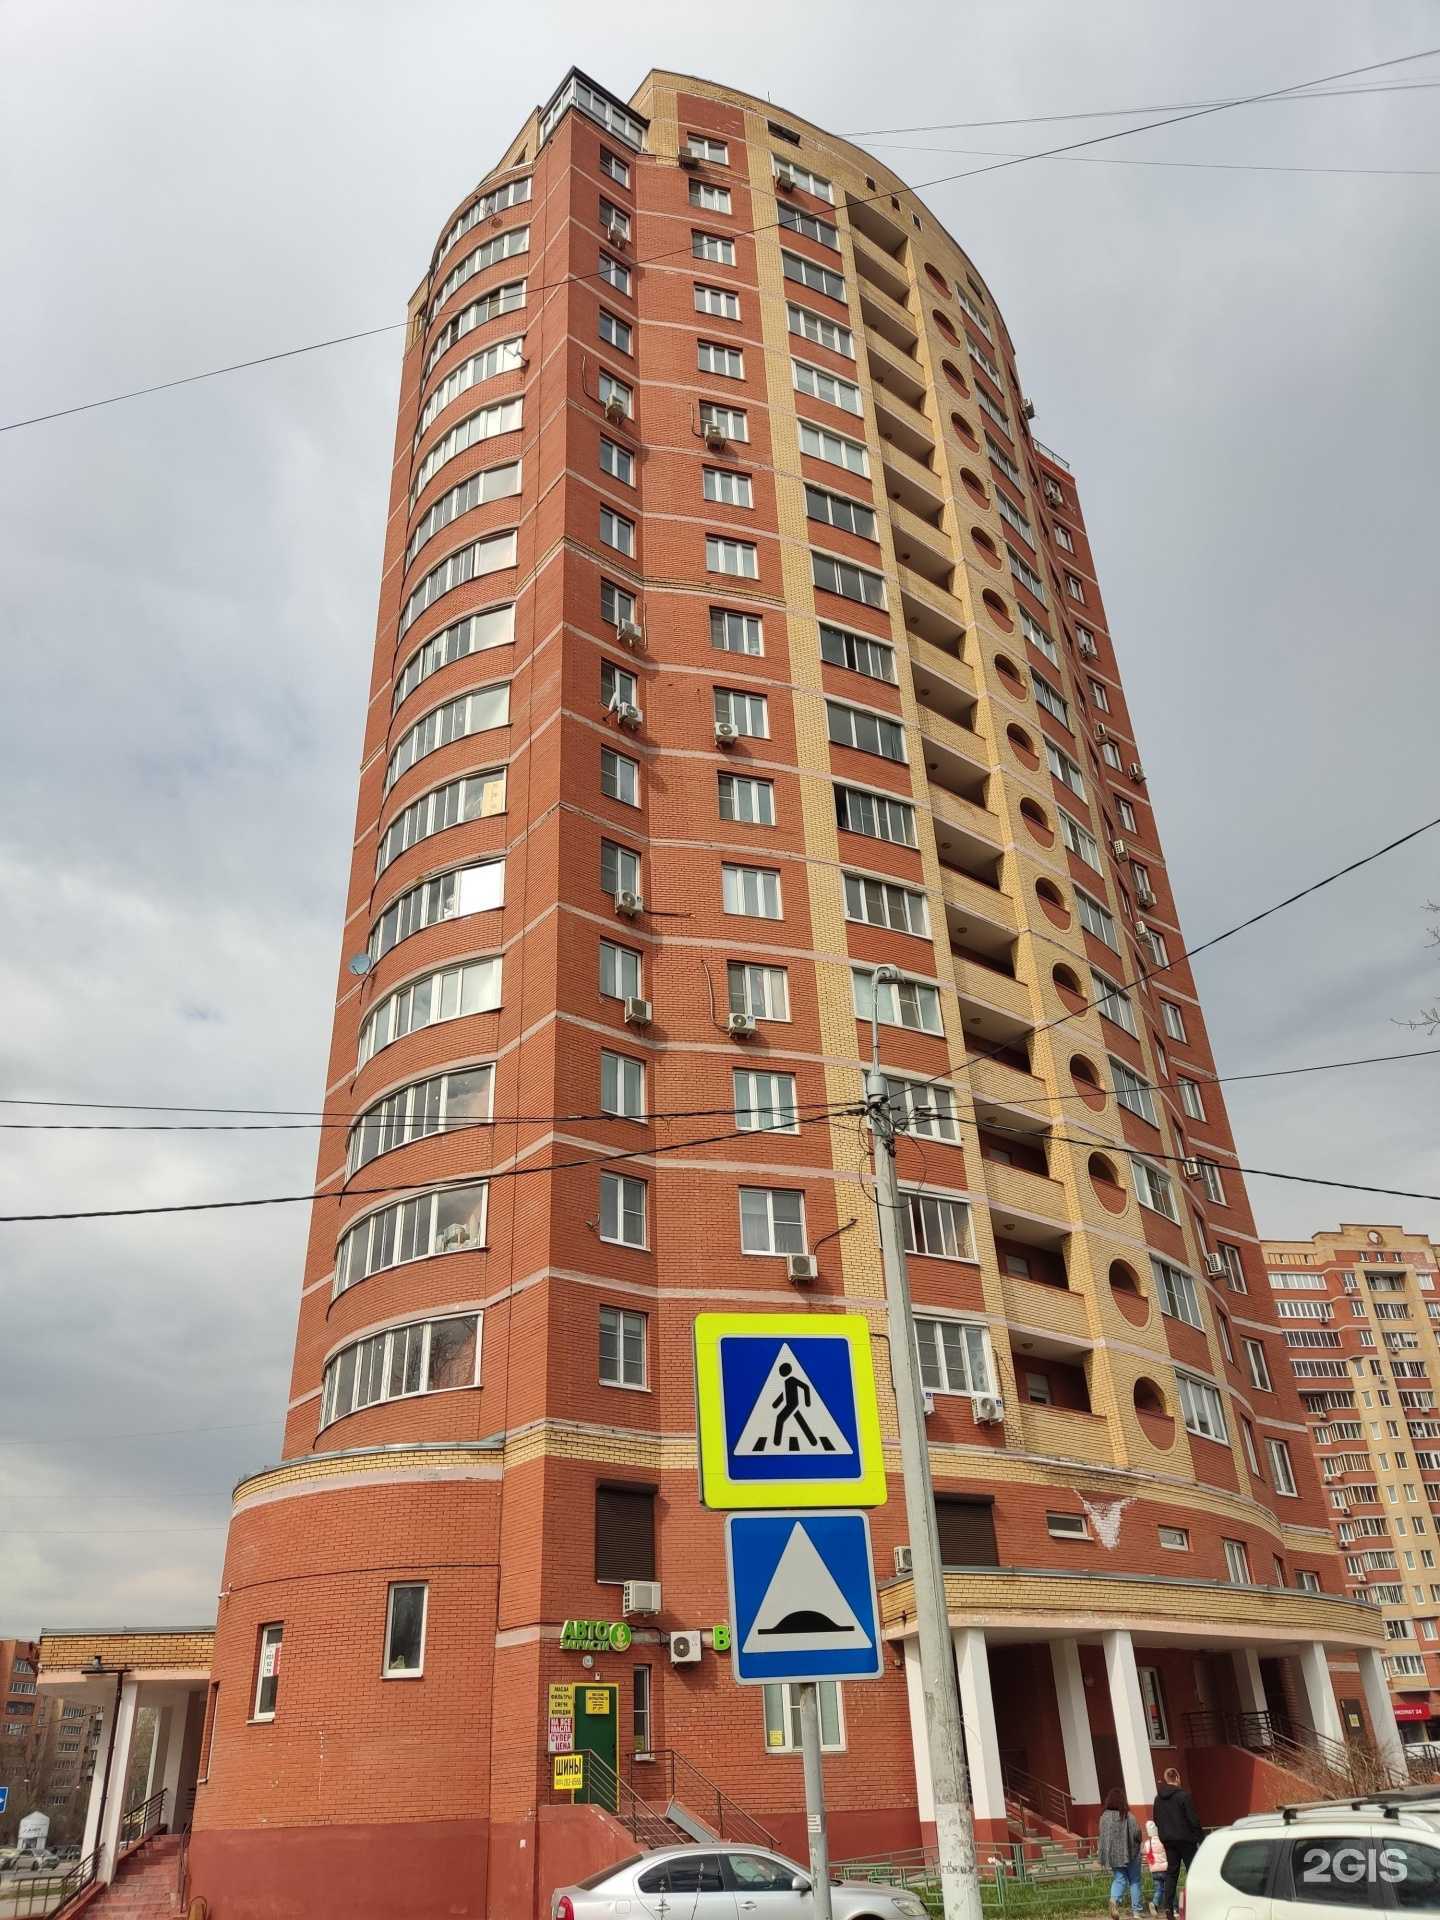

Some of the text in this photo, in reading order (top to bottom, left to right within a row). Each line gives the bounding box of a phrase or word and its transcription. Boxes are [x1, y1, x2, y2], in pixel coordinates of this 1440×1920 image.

[560, 1620, 609, 1640] АВТО
[551, 1734, 571, 1742] СУПЕР
[555, 1742, 571, 1751] ЦЕНА
[555, 1758, 582, 1776] ШИНЫ
